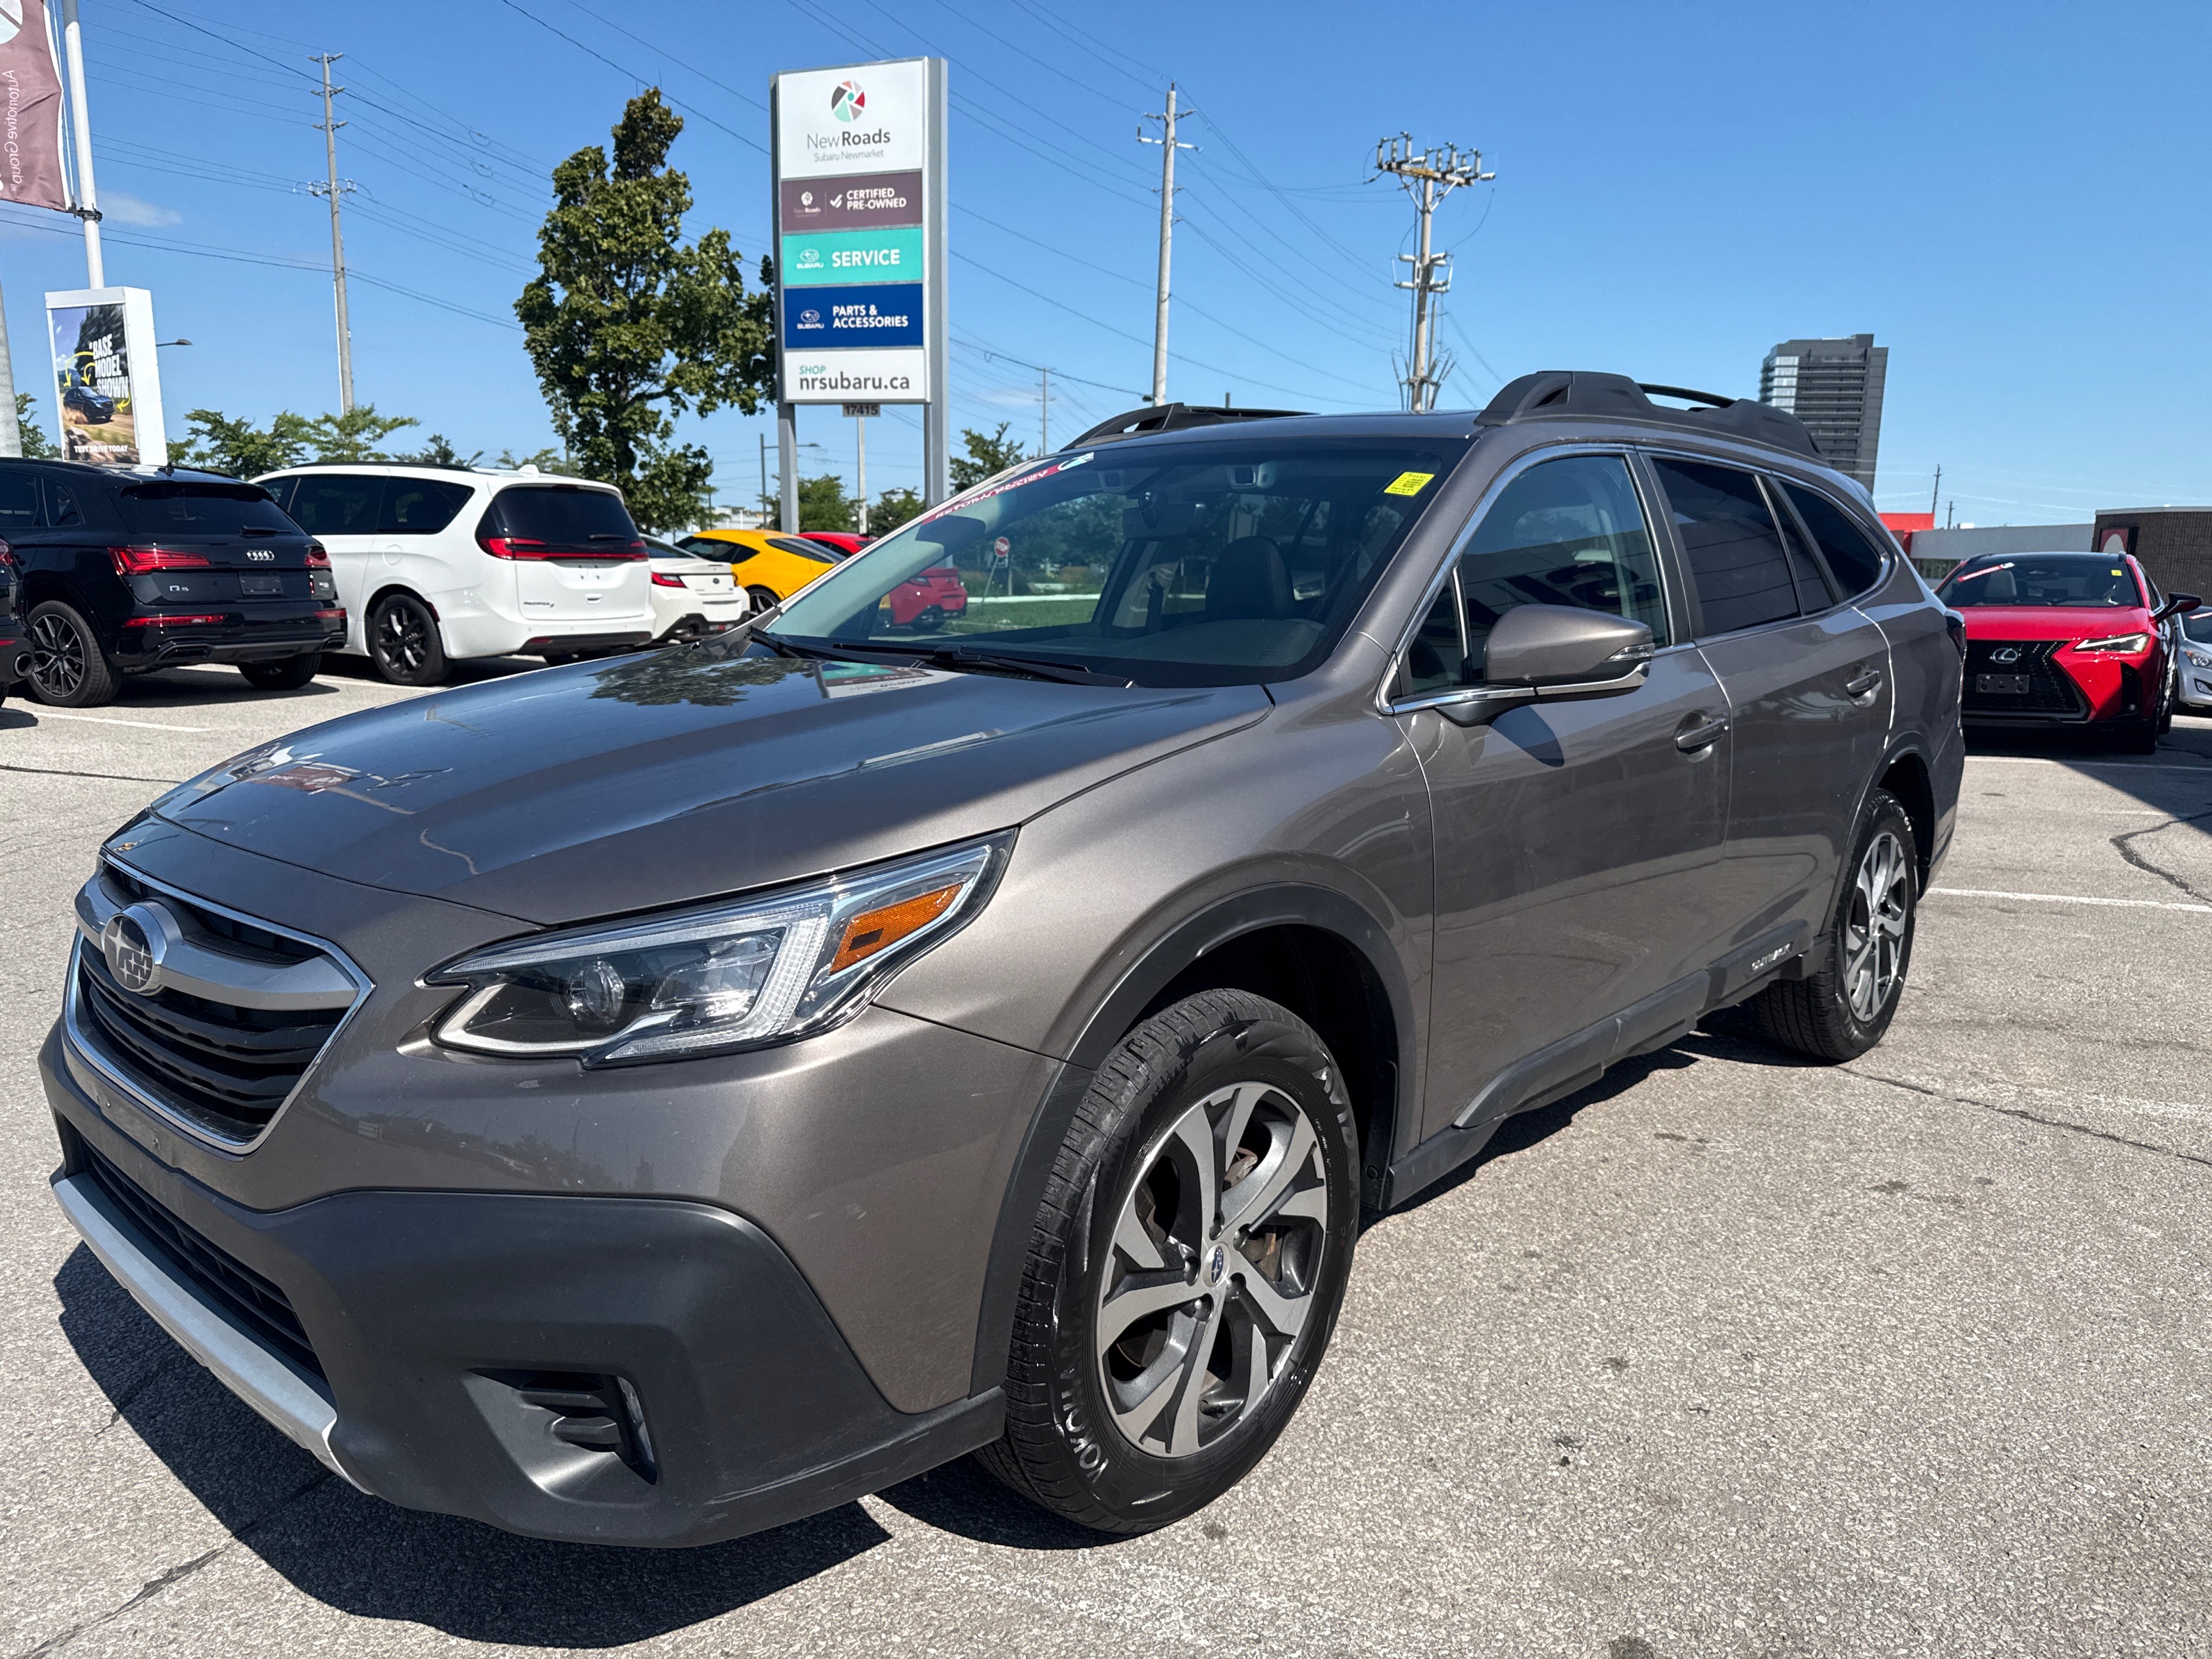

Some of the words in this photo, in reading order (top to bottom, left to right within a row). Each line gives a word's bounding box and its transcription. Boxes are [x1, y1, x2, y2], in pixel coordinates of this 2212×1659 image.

[814, 151, 840, 162] Subaru
[841, 149, 884, 160] Newmarket
[847, 188, 895, 200] CERTIFIED
[847, 197, 907, 210] PRE-OWNED
[832, 249, 900, 267] SERVICE
[832, 305, 866, 316] PARTS
[869, 305, 878, 315] &
[833, 315, 909, 328] ACCESSORIES
[94, 354, 122, 378] MODEL
[799, 365, 826, 374] SHOP
[96, 376, 129, 398] SHOWN
[799, 371, 909, 390] nrsubaru.ca
[845, 405, 878, 415] 17415
